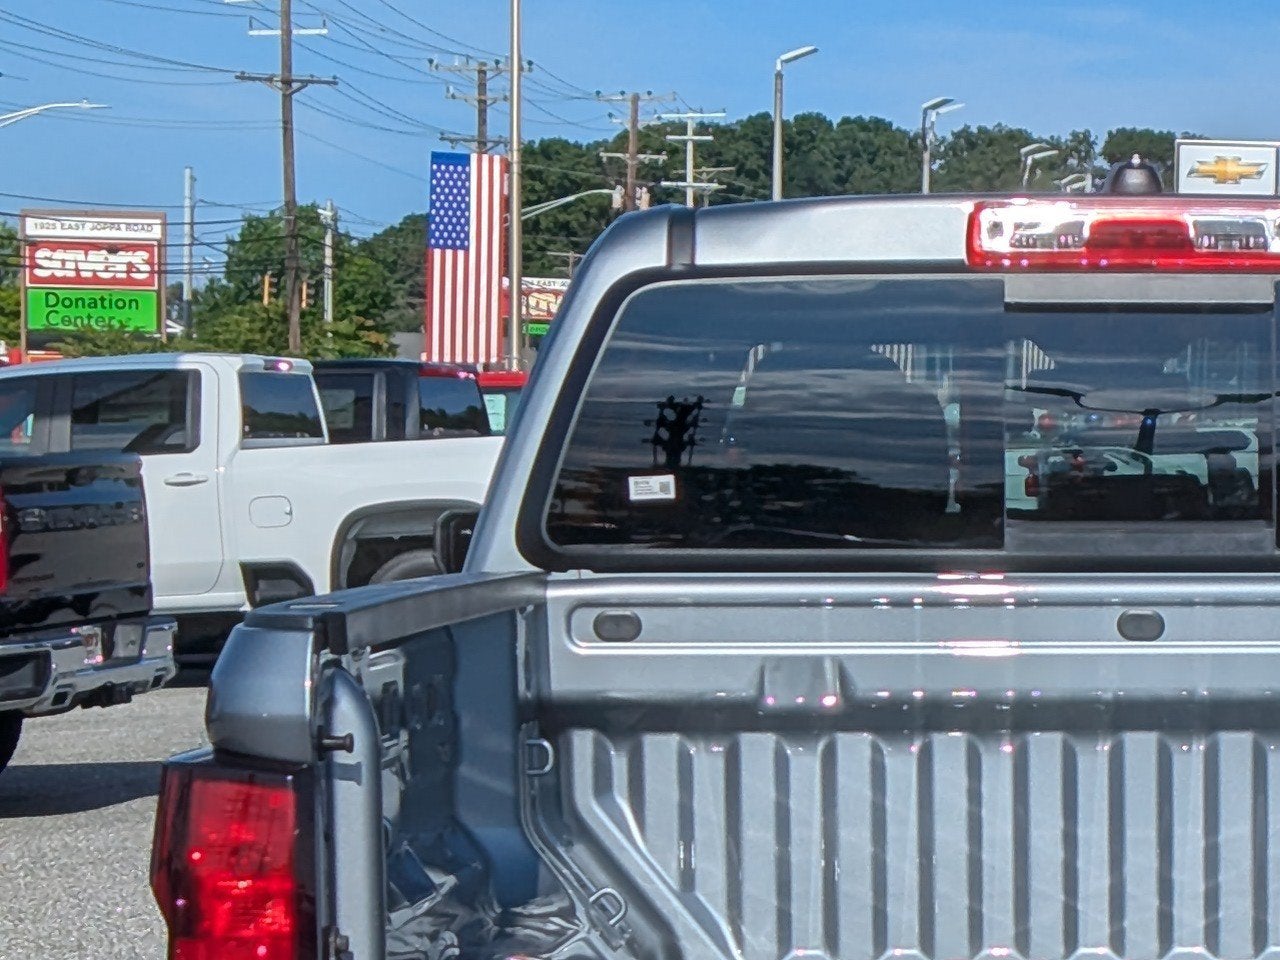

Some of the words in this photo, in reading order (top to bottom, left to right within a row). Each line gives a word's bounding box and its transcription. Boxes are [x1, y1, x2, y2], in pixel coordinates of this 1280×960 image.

[61, 222, 87, 231] EAST
[126, 223, 154, 233] ROAD
[44, 292, 139, 311] Donation
[45, 310, 118, 328] Center
